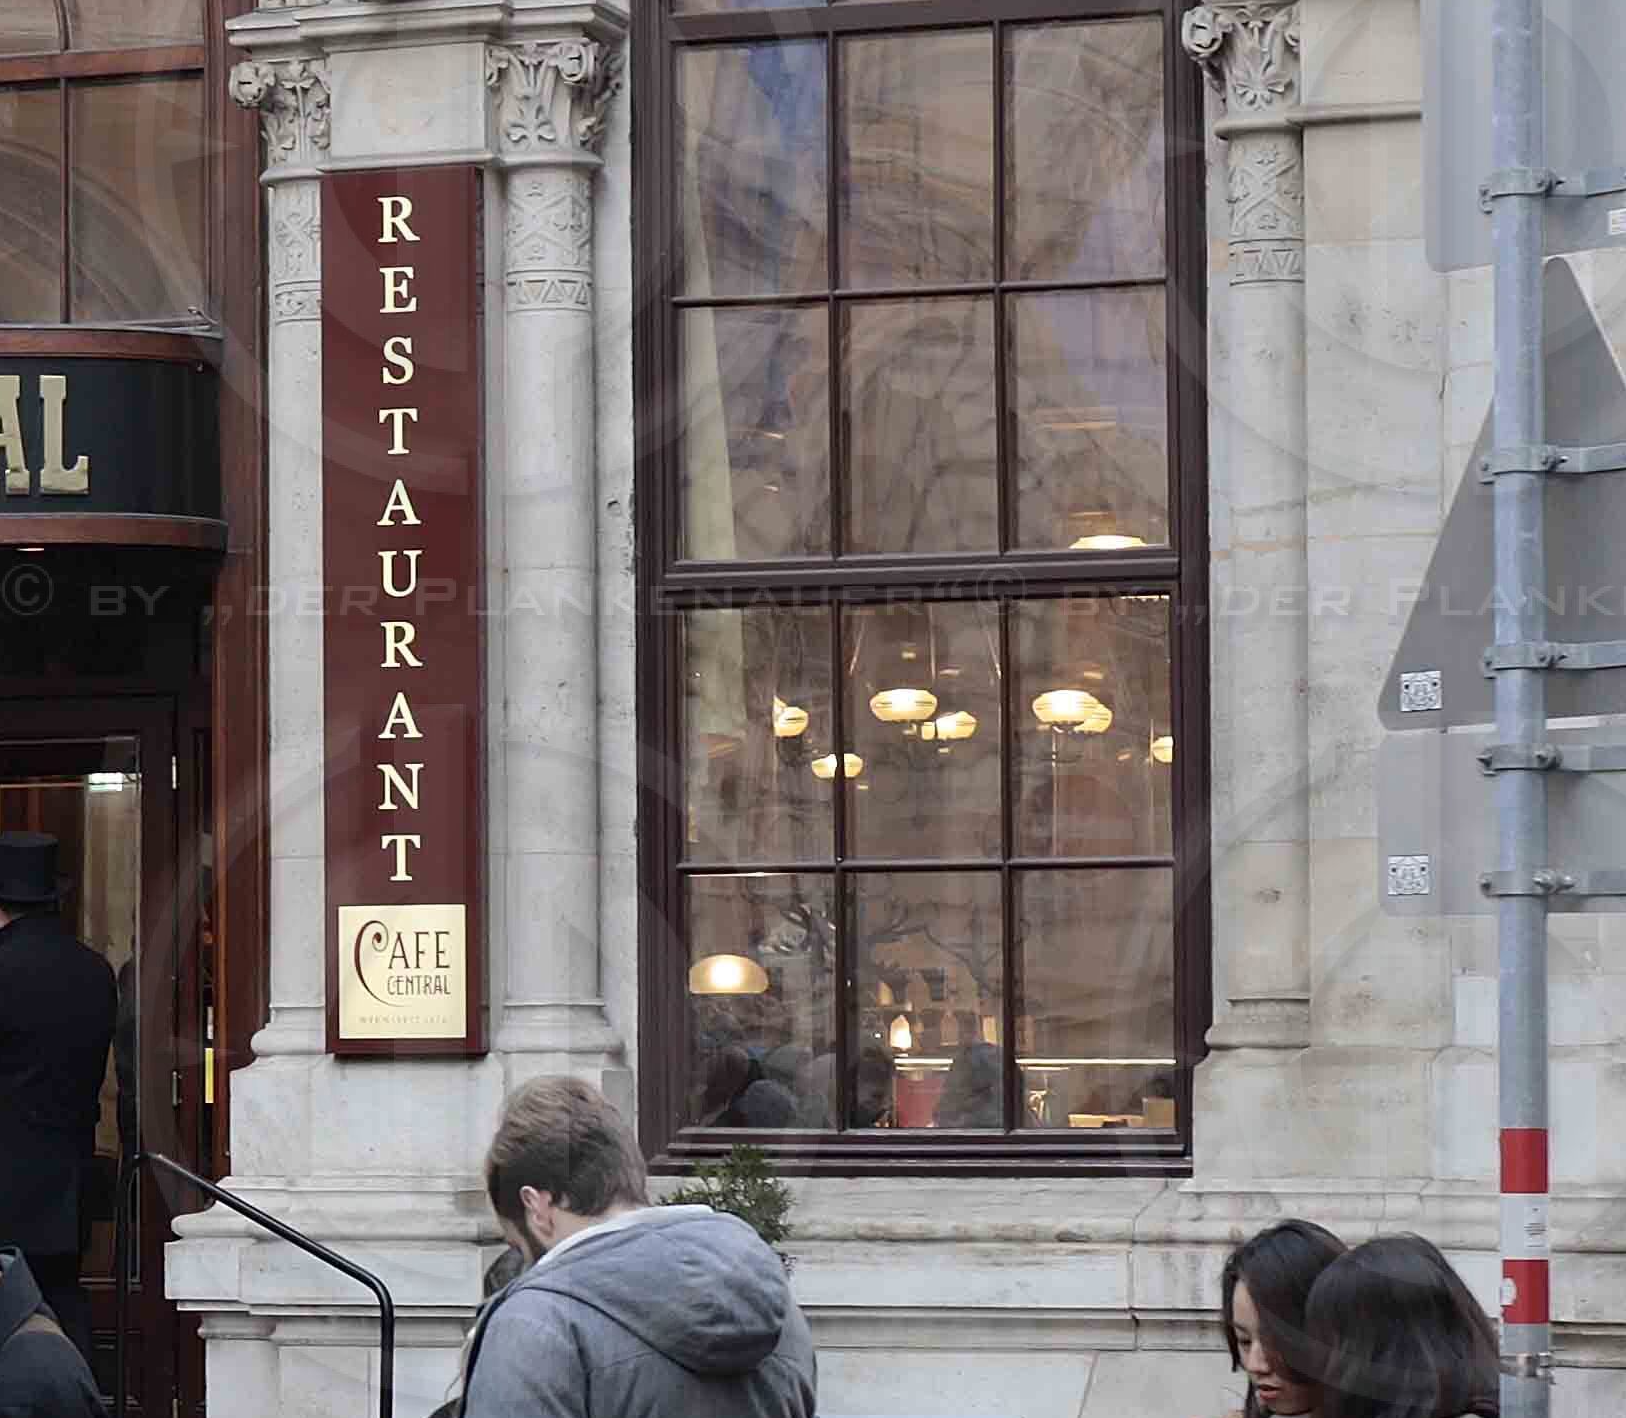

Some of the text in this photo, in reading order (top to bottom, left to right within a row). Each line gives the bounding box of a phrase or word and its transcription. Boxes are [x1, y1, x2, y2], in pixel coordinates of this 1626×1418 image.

[377, 196, 424, 881] RESTAURANT
[354, 920, 451, 1007] CAFE
[387, 974, 451, 995] CENTRAL
